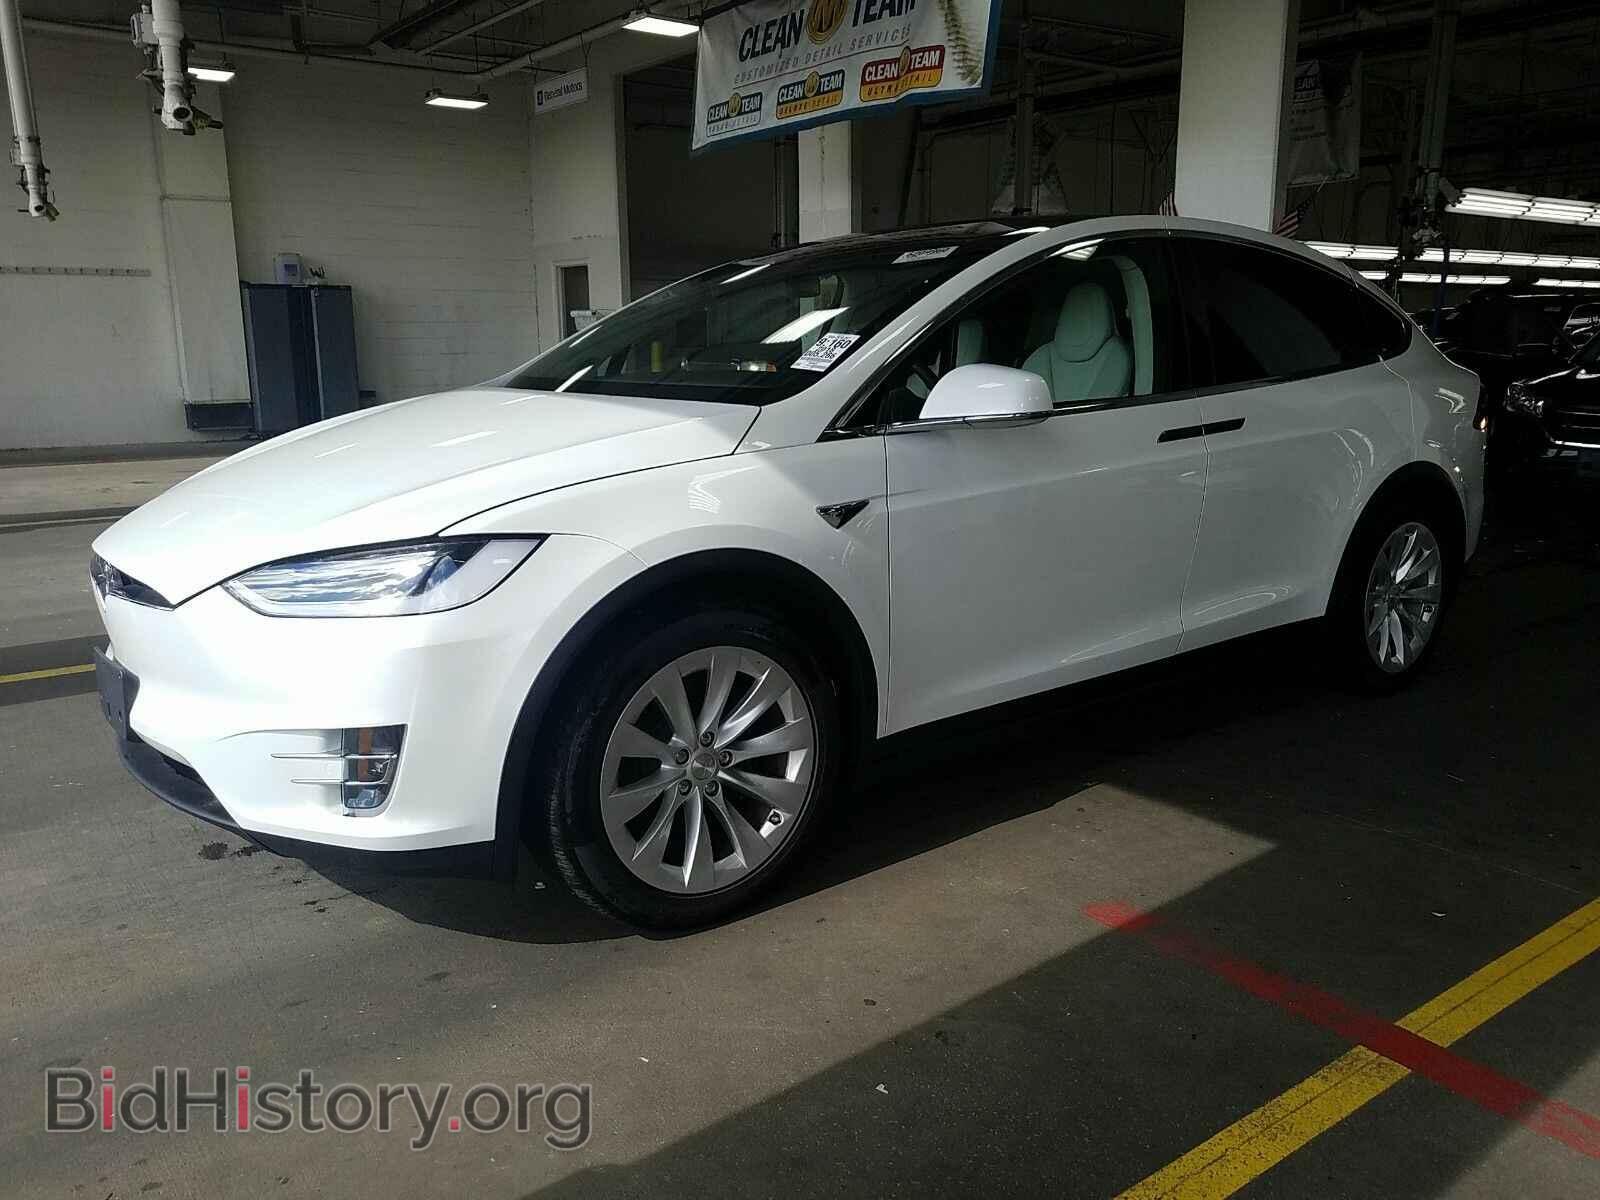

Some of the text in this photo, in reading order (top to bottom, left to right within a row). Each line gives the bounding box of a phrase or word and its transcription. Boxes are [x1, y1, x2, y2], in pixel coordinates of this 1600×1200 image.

[739, 9, 805, 62] CLEAN
[805, 43, 843, 64] DETAIL
[850, 24, 911, 50] SERVICES
[865, 49, 940, 82] CLEAN TEAM
[778, 71, 843, 102] CLEAN TEAM
[708, 95, 761, 122] CLEAN TEAM
